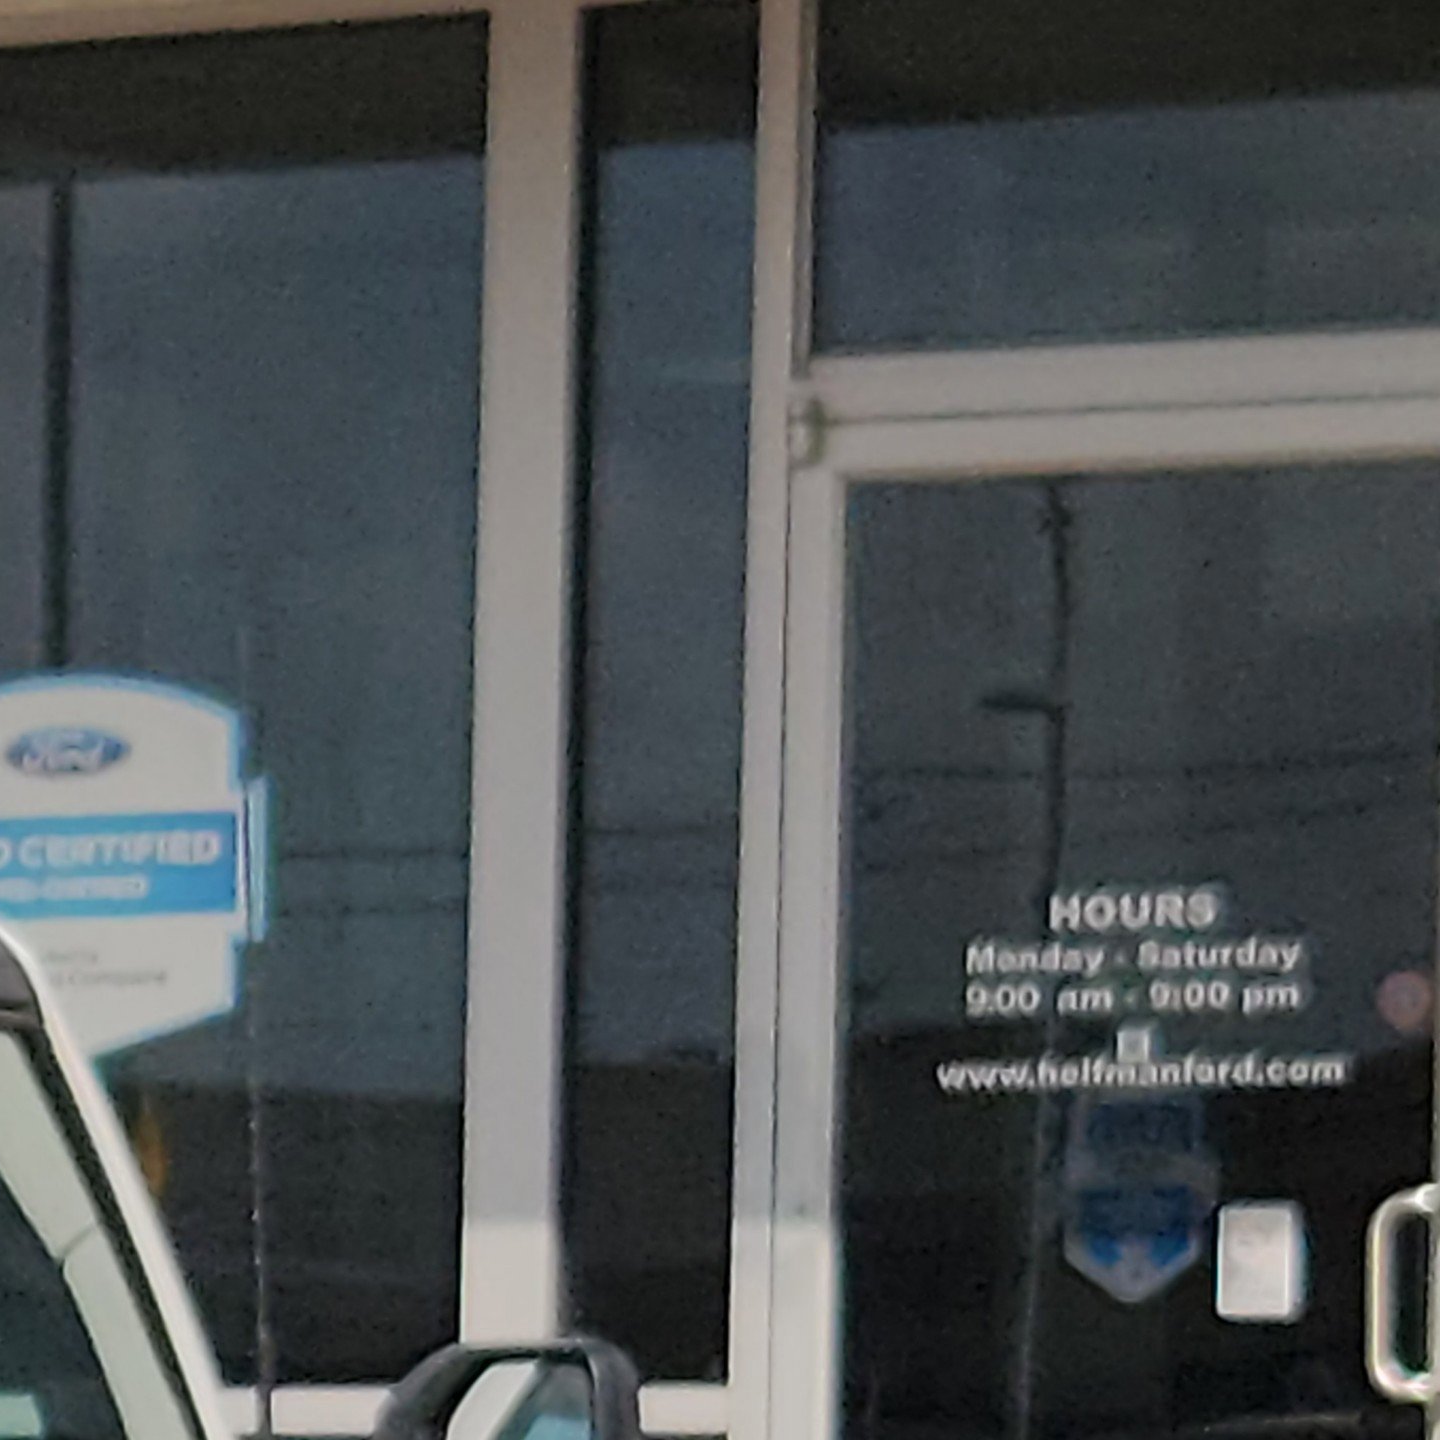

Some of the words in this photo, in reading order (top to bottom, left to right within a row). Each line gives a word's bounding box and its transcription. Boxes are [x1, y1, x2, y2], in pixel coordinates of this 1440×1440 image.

[19, 830, 221, 870] CERTIFIED
[1049, 891, 1218, 931] HOURS
[966, 944, 1106, 976] Monday
[1137, 936, 1302, 971] Saturday
[1058, 989, 1112, 1013] am
[1243, 988, 1299, 1014] pm
[936, 1055, 1346, 1090] www.helfmanford.com
